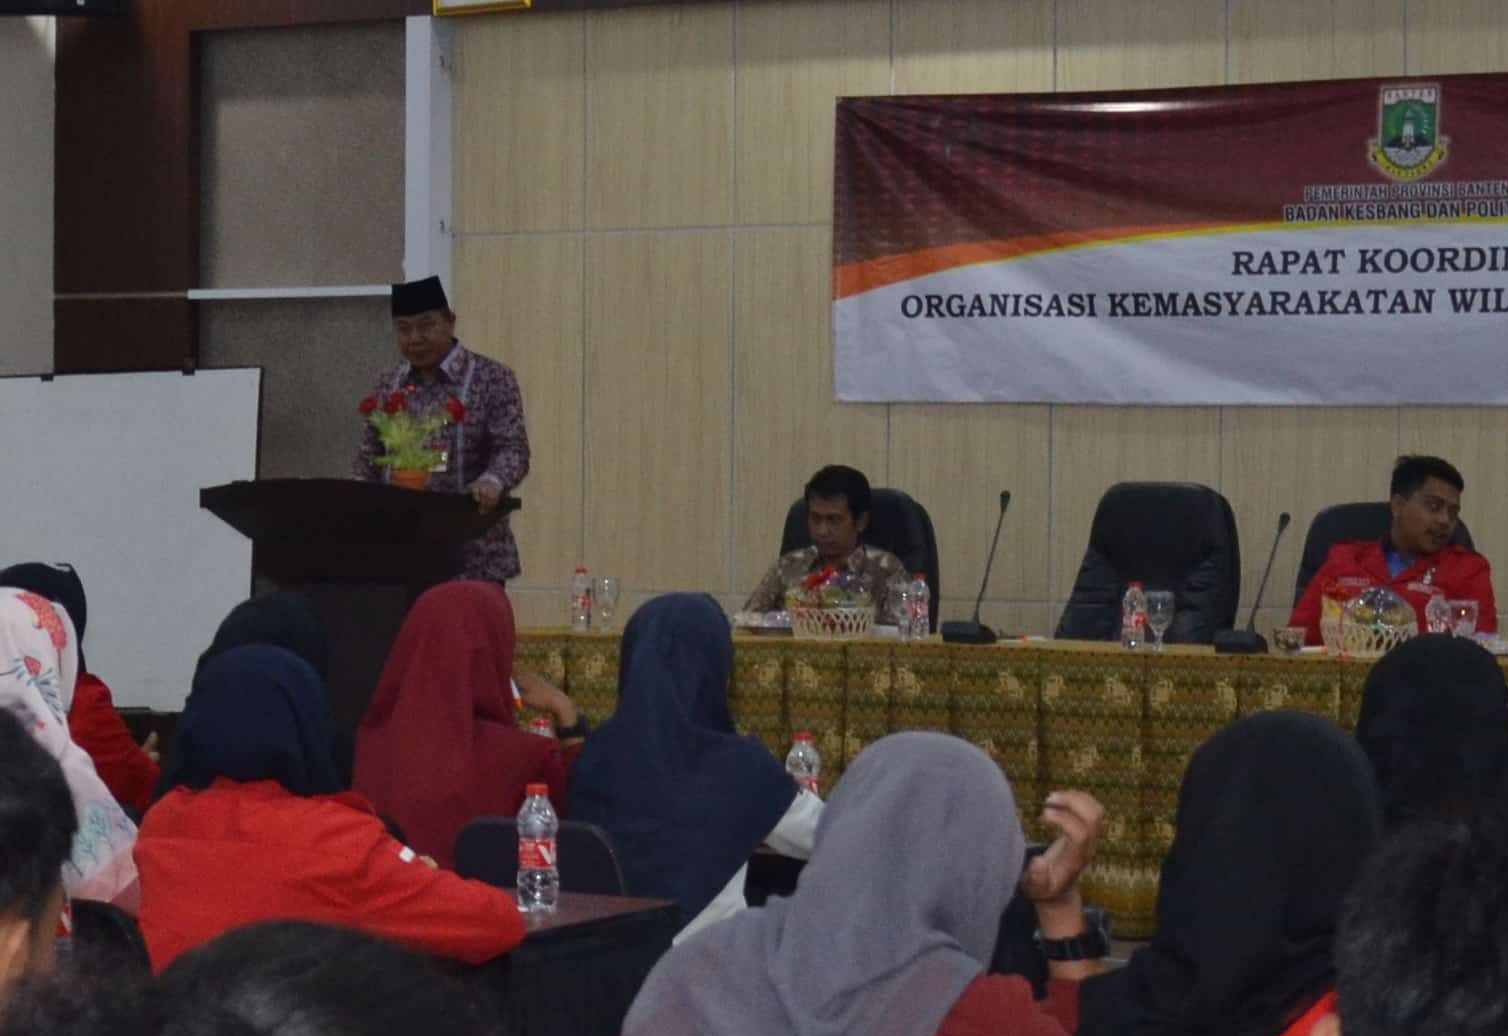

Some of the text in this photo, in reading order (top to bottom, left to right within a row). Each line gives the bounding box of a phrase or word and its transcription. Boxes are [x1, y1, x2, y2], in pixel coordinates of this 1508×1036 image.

[1305, 184, 1387, 201] PEMERINTAH
[1391, 182, 1455, 199] PROVINSI
[1285, 204, 1341, 222] BADAN
[1345, 202, 1422, 221] KESBANG
[1426, 200, 1462, 219] DAN
[1231, 250, 1346, 275] RAPAT
[900, 293, 1098, 319] ORGANISASI
[1108, 288, 1435, 317] KEMASYARAKATAN
